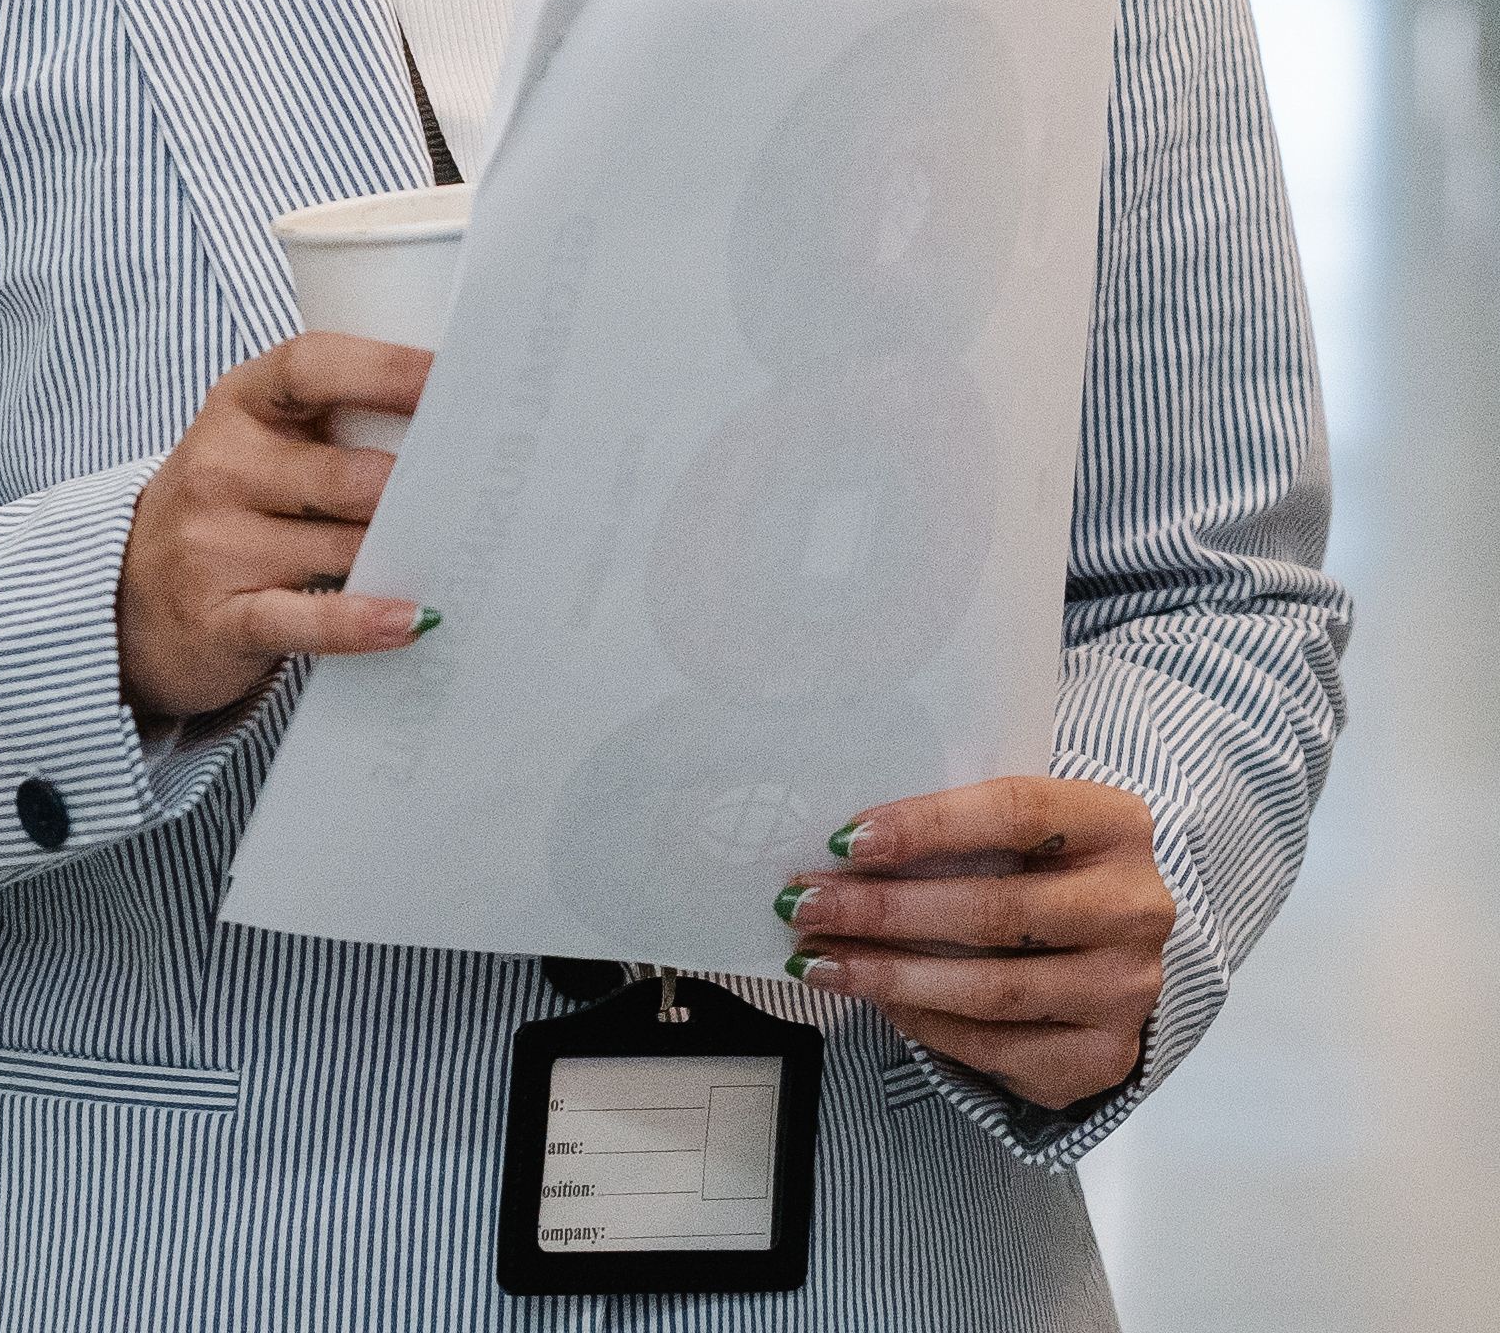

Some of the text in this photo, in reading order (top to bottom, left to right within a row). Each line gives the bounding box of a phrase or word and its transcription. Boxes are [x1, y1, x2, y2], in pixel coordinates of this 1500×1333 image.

[550, 1099, 564, 1112] o:
[547, 1141, 583, 1155] ame:
[542, 1180, 595, 1198] osition:
